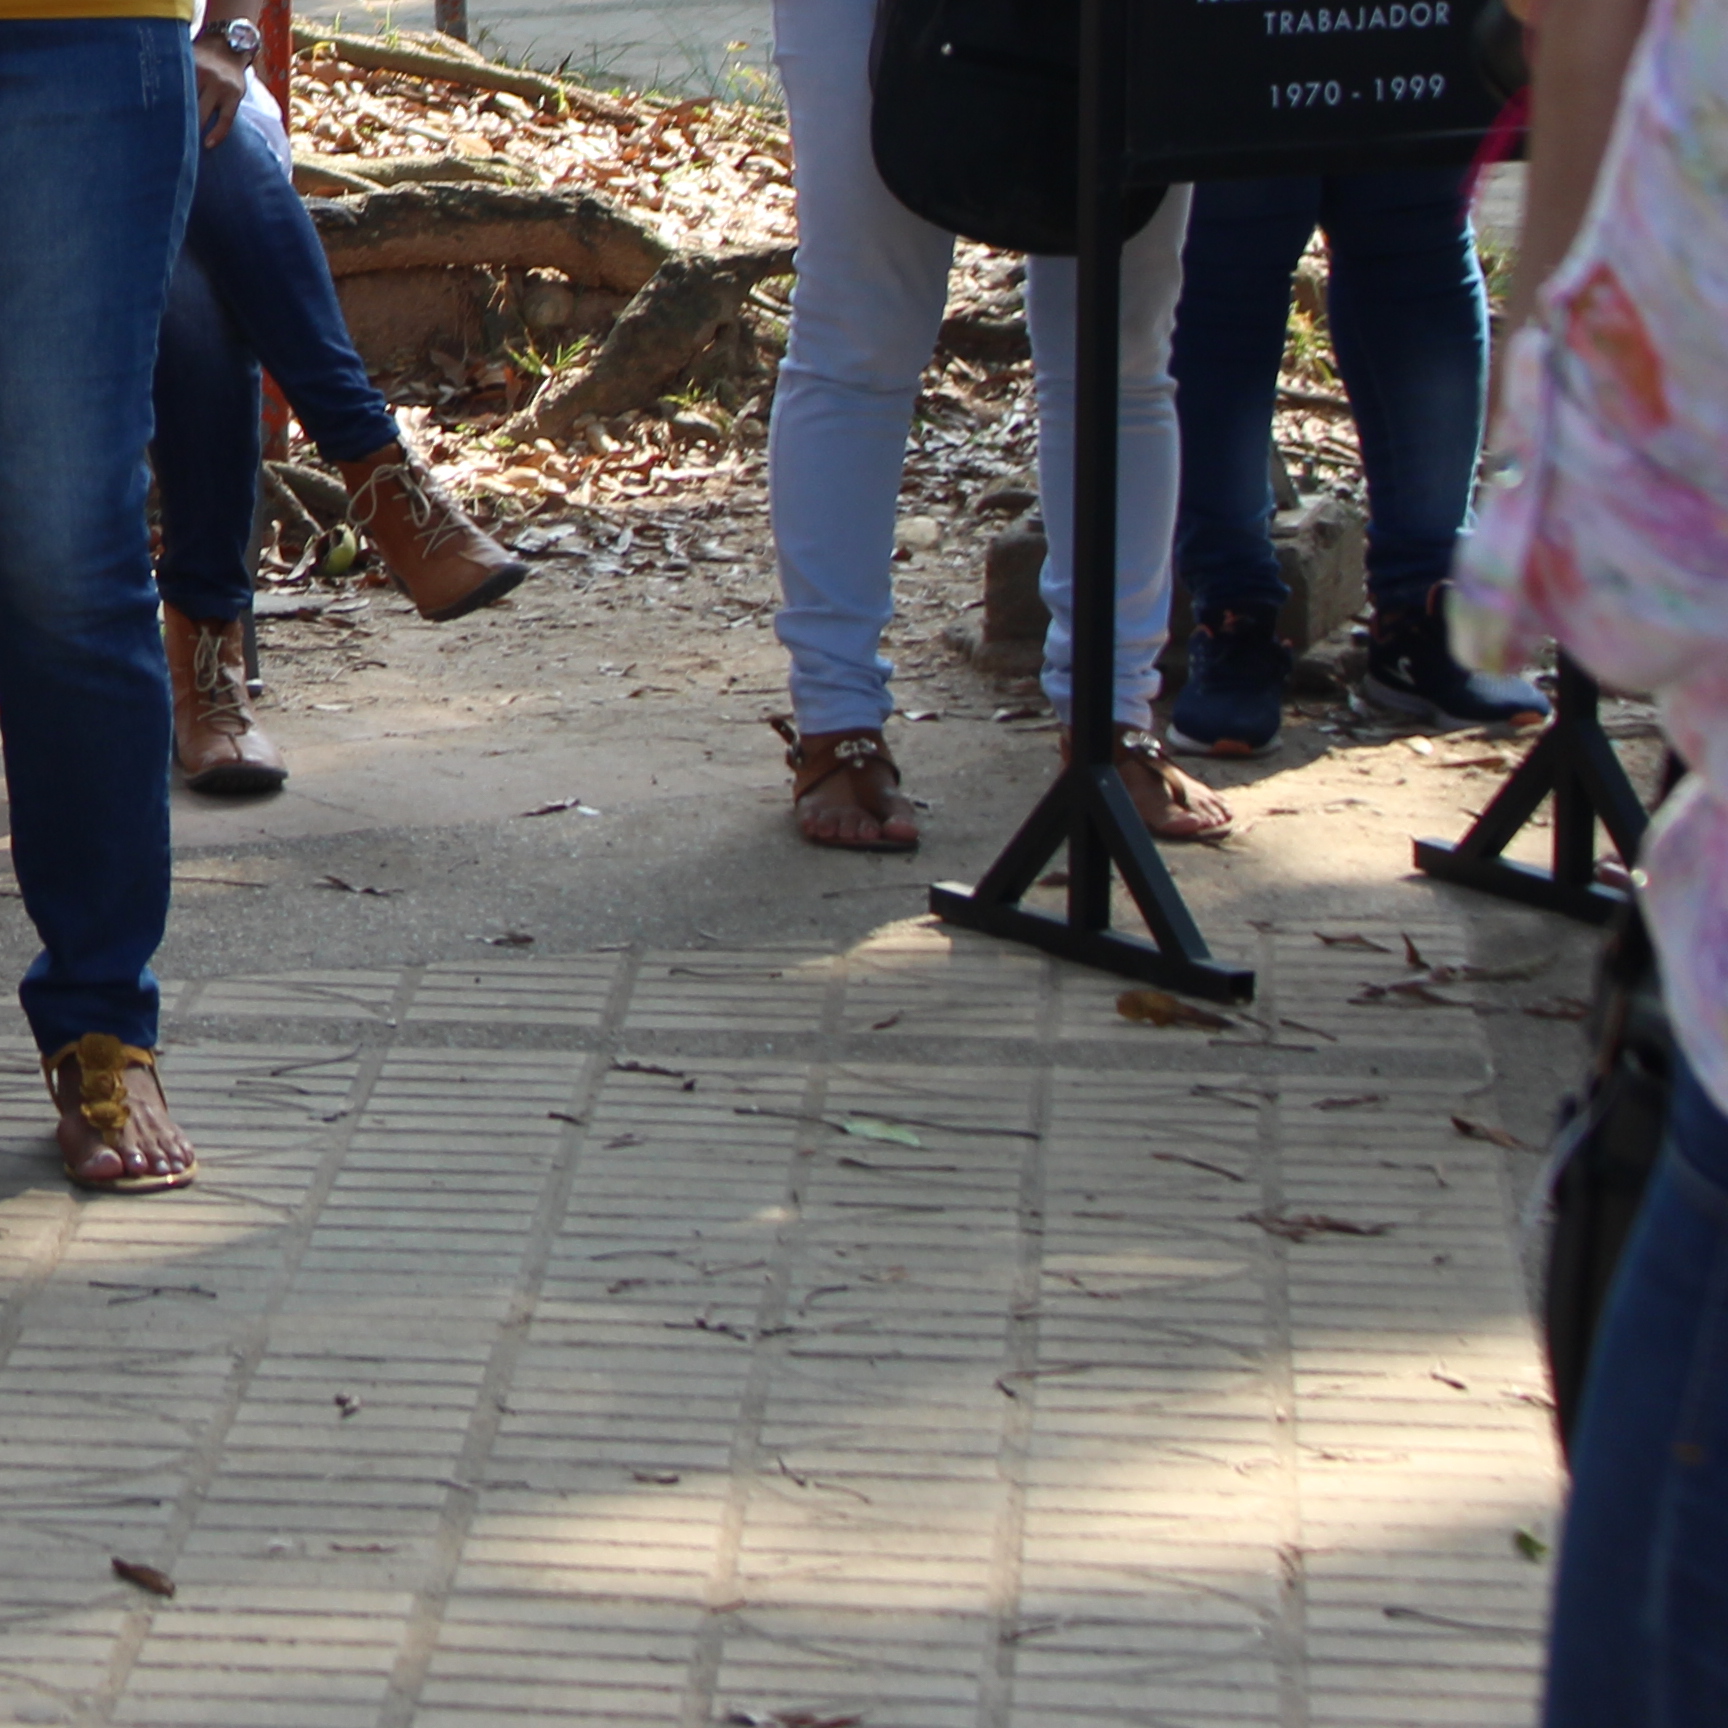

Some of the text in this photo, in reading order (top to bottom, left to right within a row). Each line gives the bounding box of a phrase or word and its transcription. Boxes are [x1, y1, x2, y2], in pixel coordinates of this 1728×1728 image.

[1264, 2, 1450, 35] TRABAJADOR
[1270, 80, 1341, 109] 1970
[1374, 74, 1446, 102] 1999
